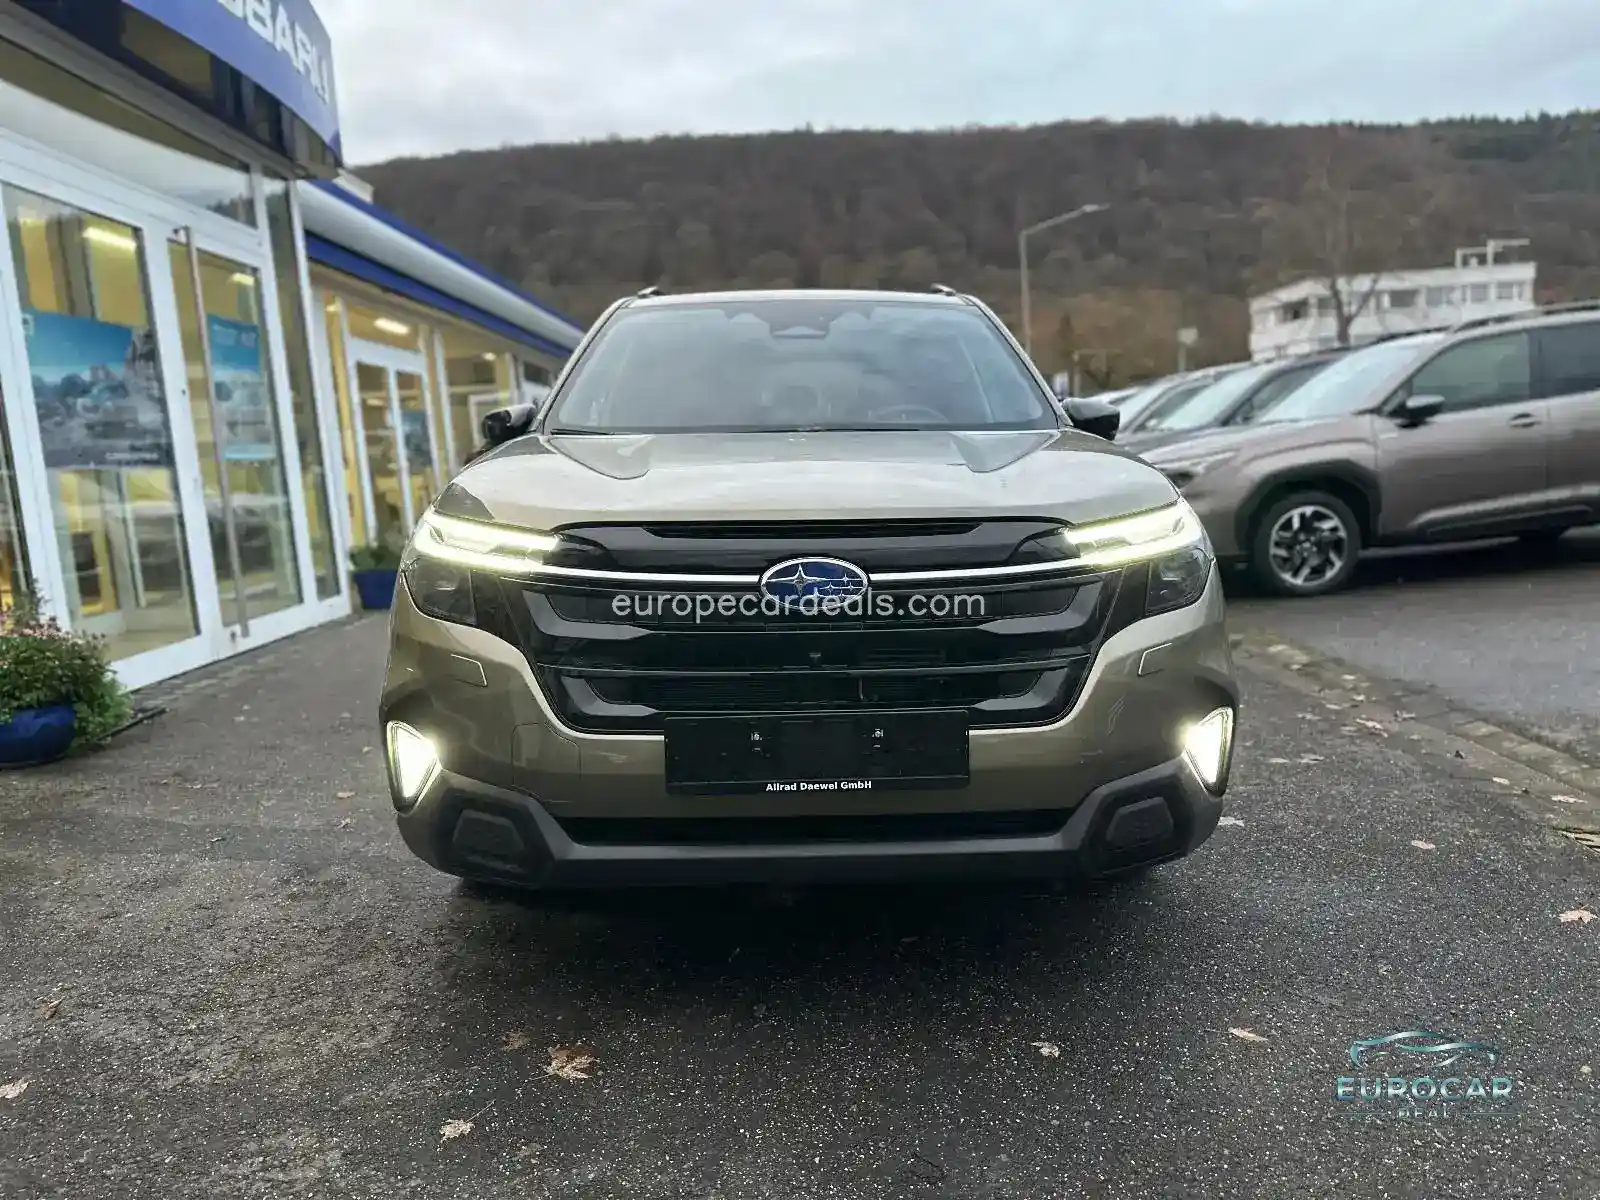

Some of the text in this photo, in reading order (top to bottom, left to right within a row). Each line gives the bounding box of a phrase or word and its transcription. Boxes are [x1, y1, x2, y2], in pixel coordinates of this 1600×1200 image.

[765, 780, 872, 791] Allrad Daewel GmbH
